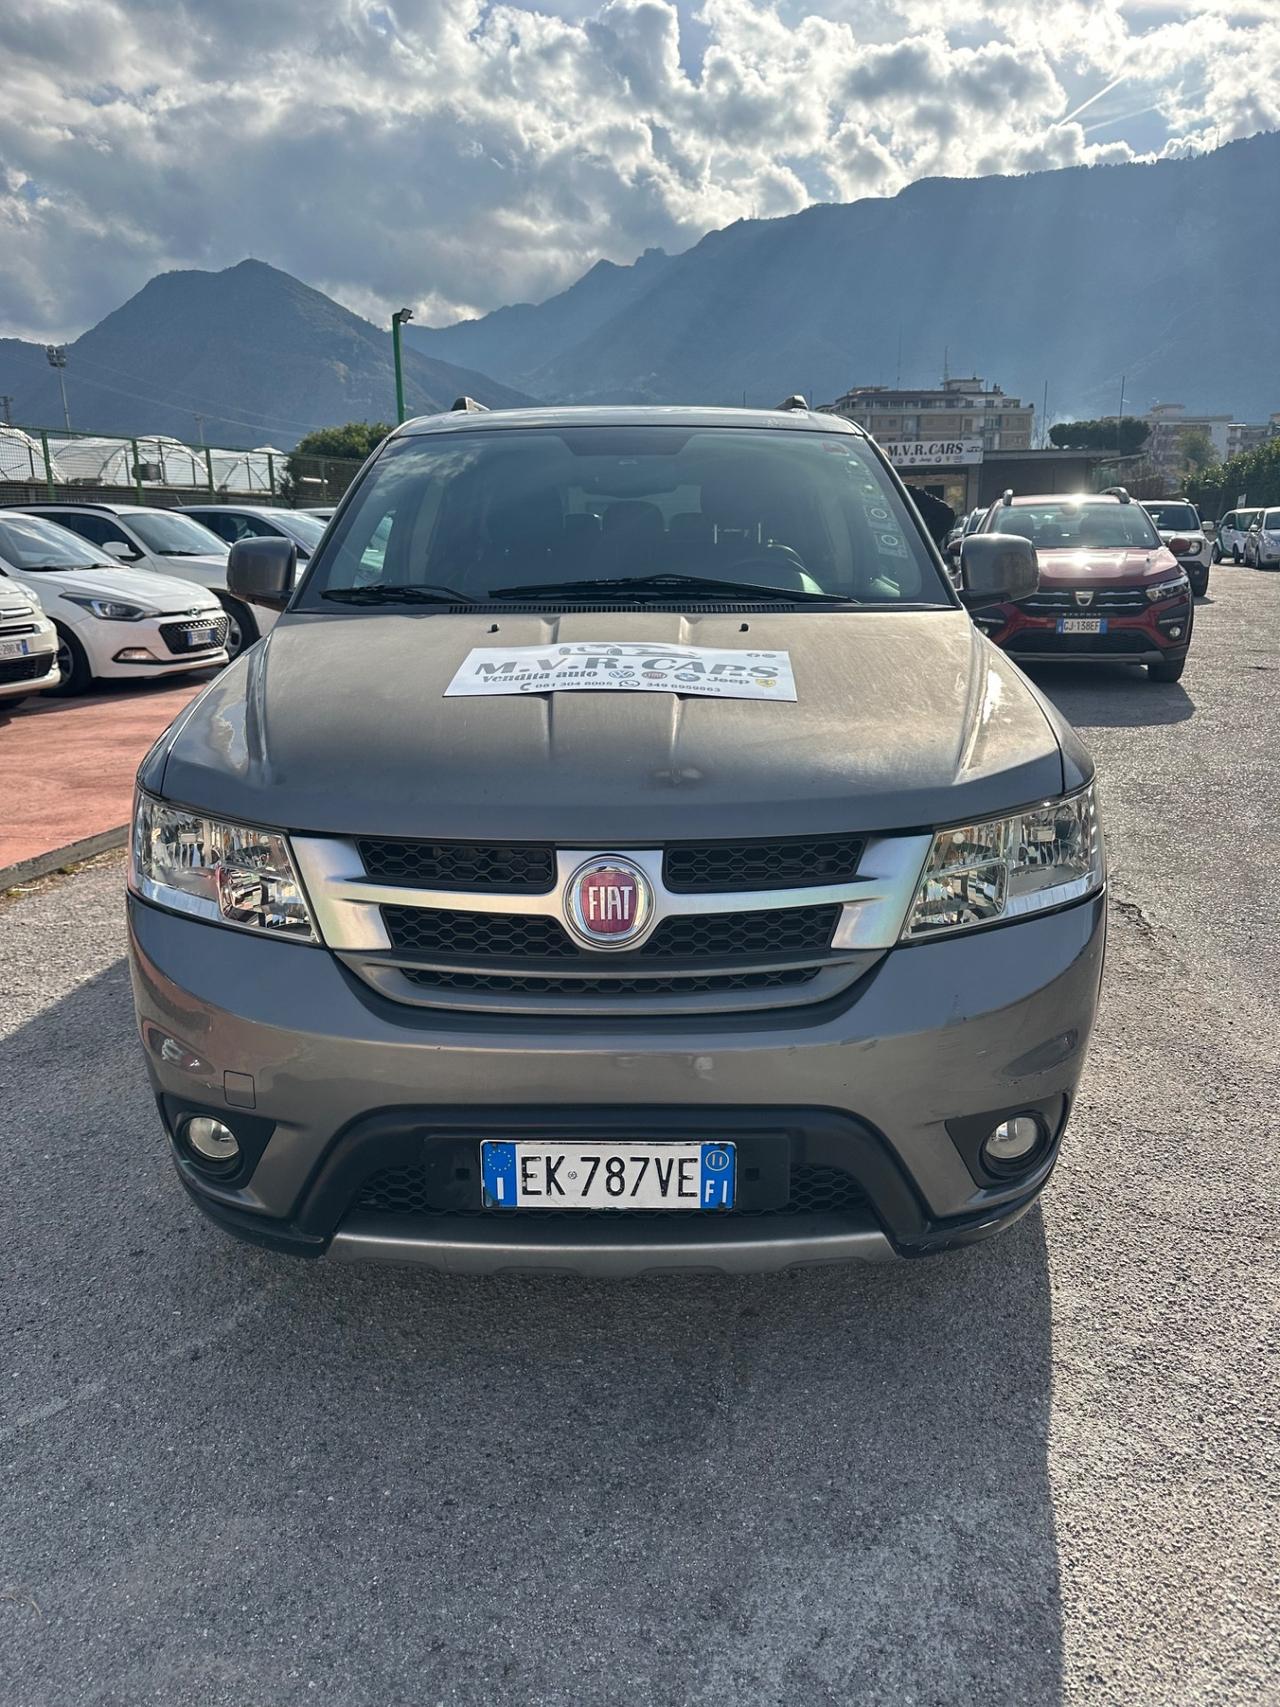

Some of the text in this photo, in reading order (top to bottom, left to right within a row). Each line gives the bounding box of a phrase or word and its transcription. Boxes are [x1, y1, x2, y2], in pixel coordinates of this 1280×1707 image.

[482, 670, 598, 683] Vendita auto
[706, 676, 750, 685] Jeep
[588, 886, 633, 920] FIAT
[496, 1176, 505, 1200] I
[704, 1180, 728, 1203] FI
